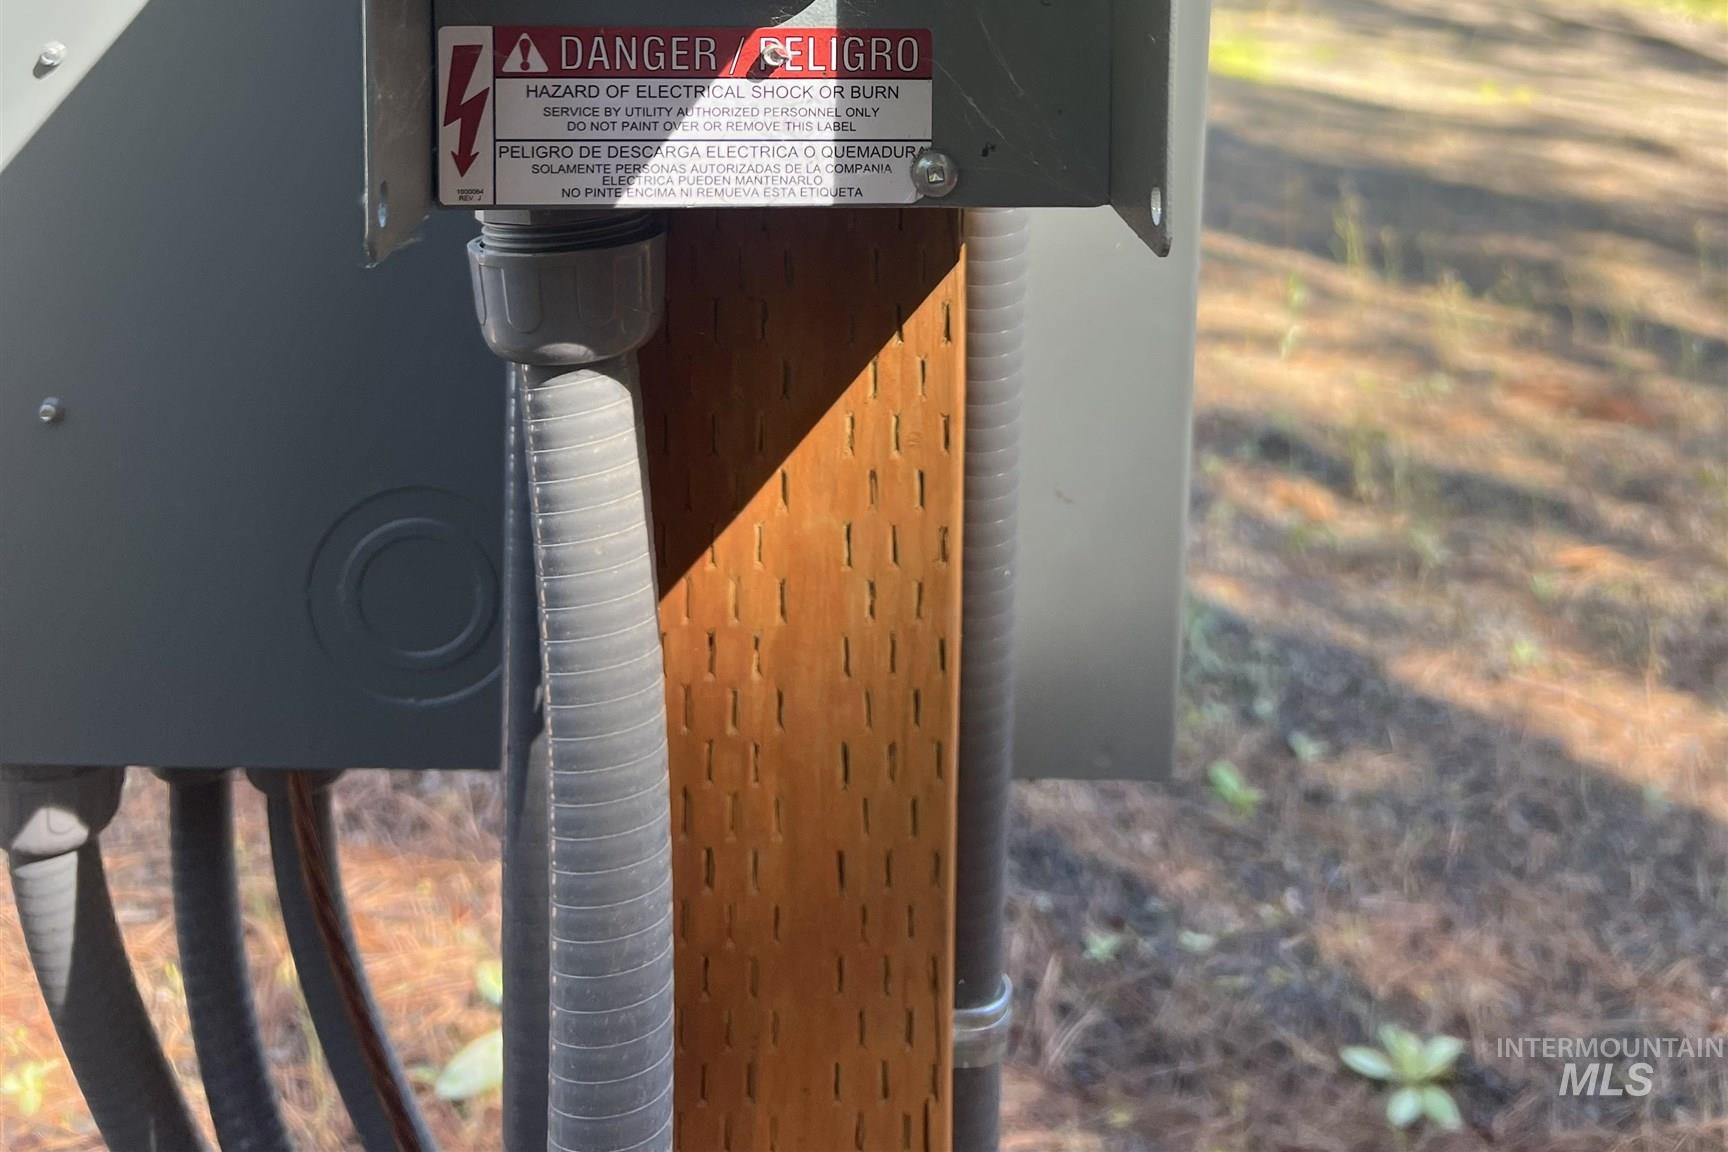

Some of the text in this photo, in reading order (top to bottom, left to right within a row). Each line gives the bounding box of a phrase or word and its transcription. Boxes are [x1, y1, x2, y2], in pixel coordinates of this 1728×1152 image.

[560, 36, 717, 72] DANGER
[526, 84, 899, 99] HAZARD OF ELECTRICAL SHOCK OR BURN
[543, 106, 880, 118] SERVICE BY UTILITY AUTHORIZED PERSONNEL ONLY
[567, 121, 856, 132] DO NOT PAINT OVER OR REMOVE THIS LABEL
[499, 145, 573, 159] PELIGRO
[579, 145, 601, 159] DE
[607, 145, 701, 159] DESCARGA
[706, 145, 798, 159] ELECTRICA
[803, 145, 816, 159] O
[531, 163, 892, 175] SOLAMENTE PERSONAS AUTORIZADAS DE LA COMPANIA
[602, 175, 823, 186] ELECTRICA PUEDEN MANTENARLO
[561, 187, 863, 198] NO PINTE ENCIMA NI REMUEVA ESTA ETIQUETA
